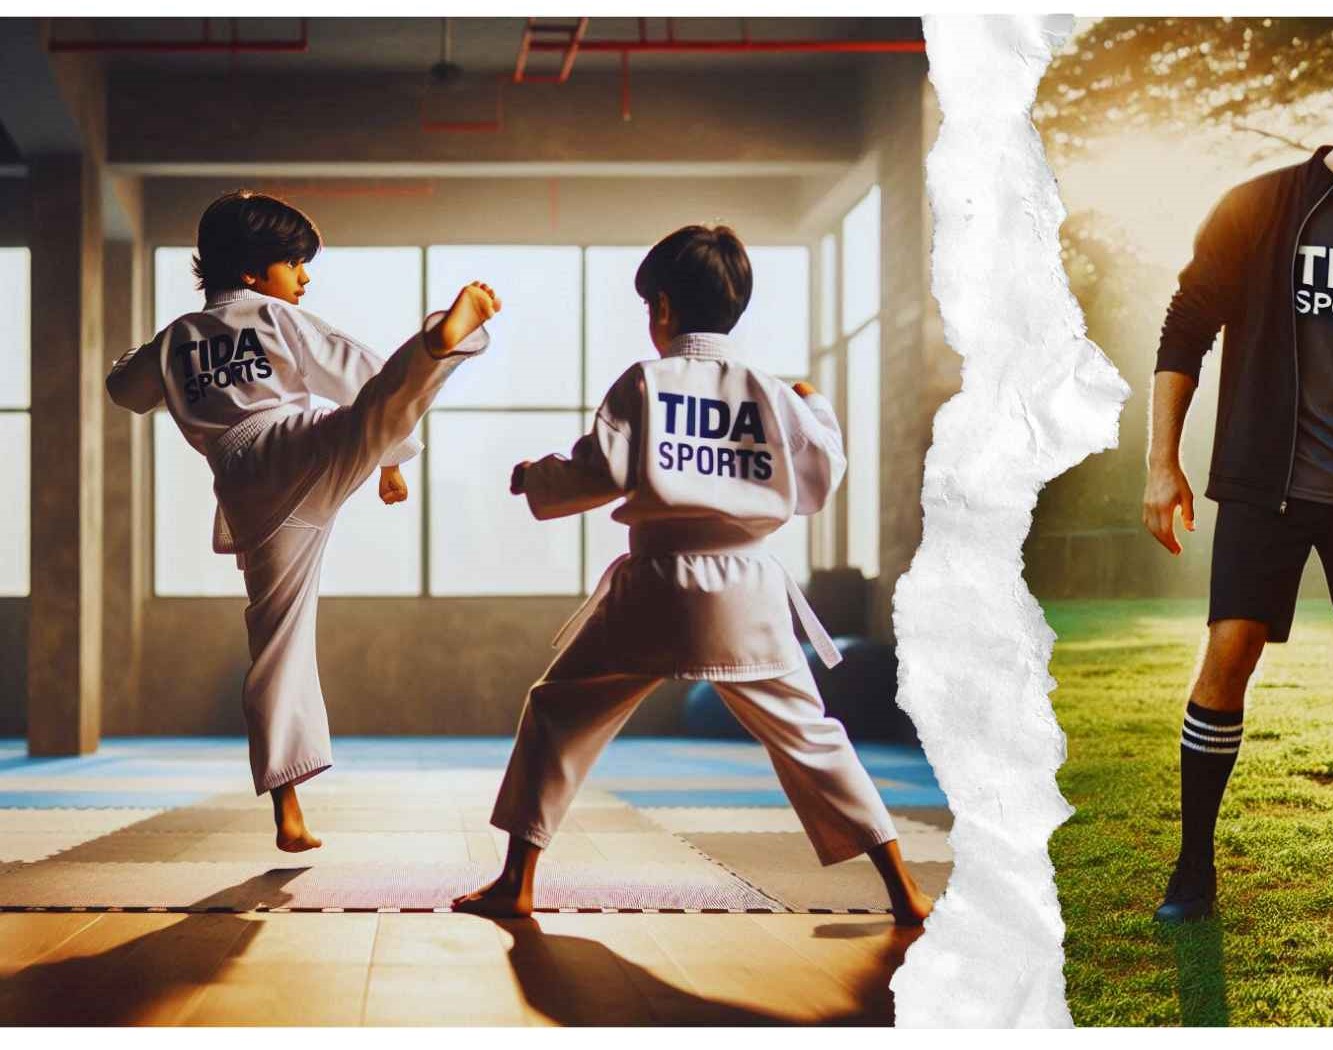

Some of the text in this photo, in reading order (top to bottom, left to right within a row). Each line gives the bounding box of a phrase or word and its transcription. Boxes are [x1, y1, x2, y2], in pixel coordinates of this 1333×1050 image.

[176, 327, 266, 382] TIDA
[183, 356, 273, 403] SPORTS
[658, 391, 767, 444] TIDA
[659, 441, 772, 481] SPORTS
